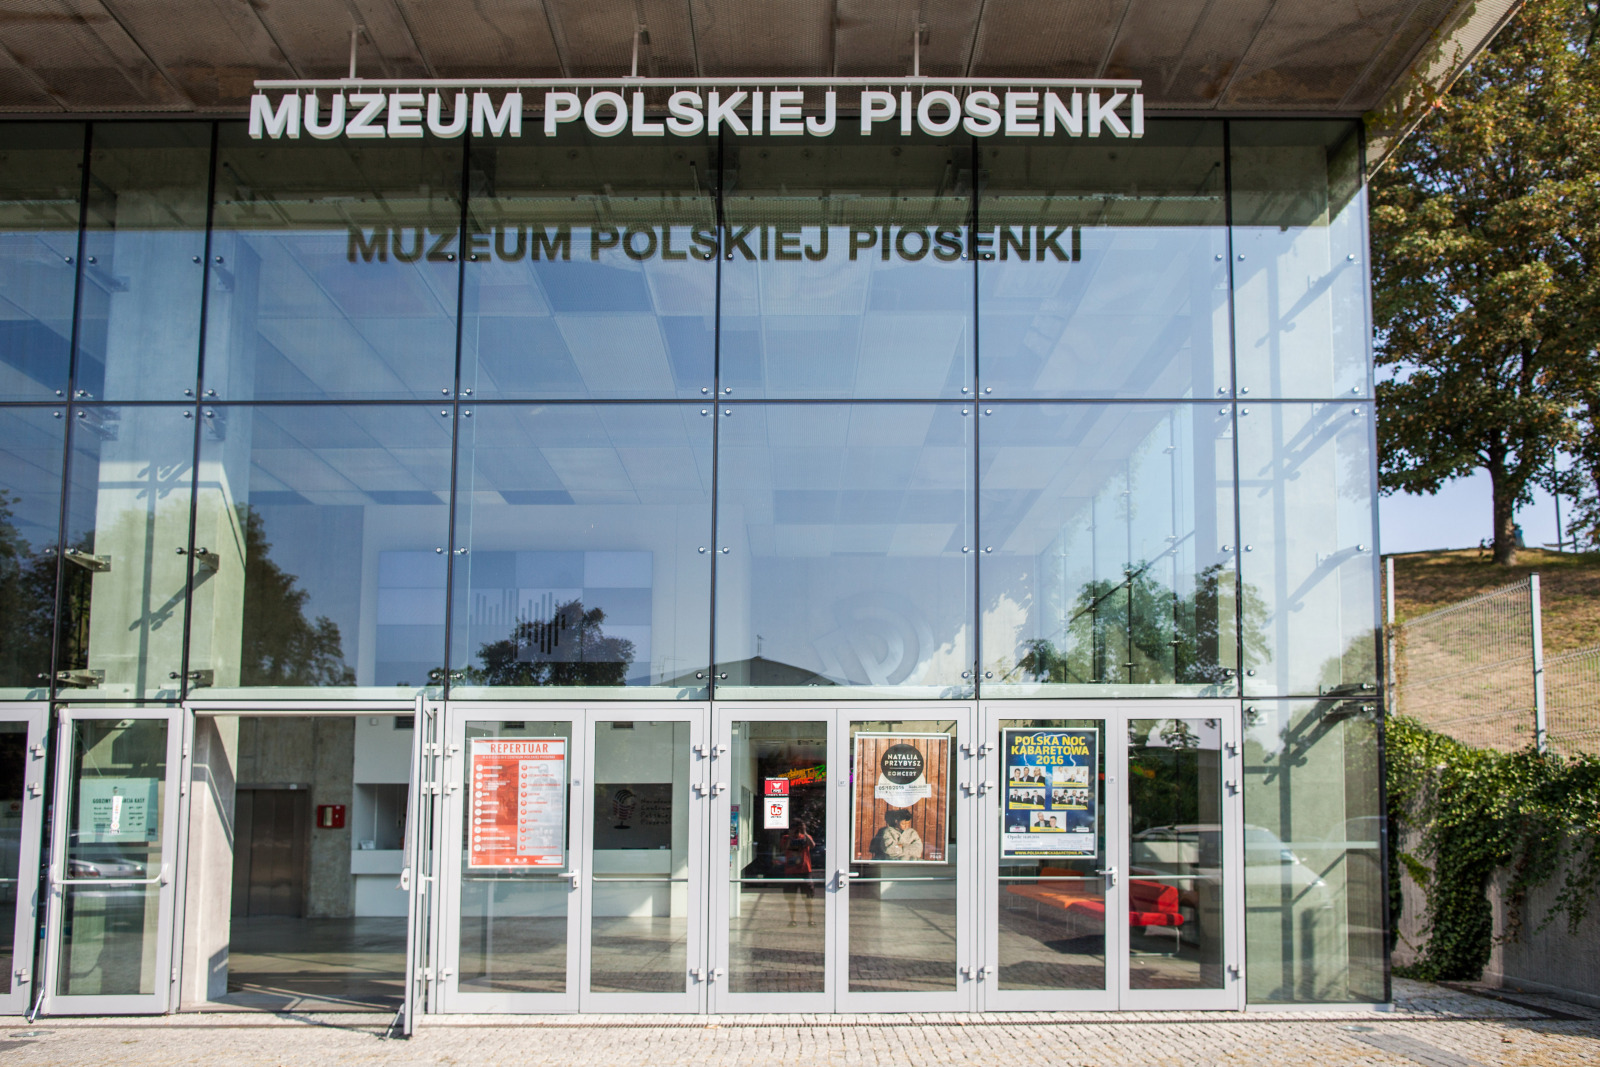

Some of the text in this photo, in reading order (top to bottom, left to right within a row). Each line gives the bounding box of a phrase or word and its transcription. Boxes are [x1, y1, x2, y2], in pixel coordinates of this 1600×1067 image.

[248, 90, 1145, 140] MUZEUM POLSKIEJ PIOSENKI
[346, 222, 1082, 264] MUZEUM POLSKIEJ PIOSENKI
[1014, 735, 1086, 746] POLSKA NOC
[490, 743, 549, 754] REPERTUAR
[1011, 746, 1089, 755] KABARETOWA
[1035, 755, 1064, 765] 2016
